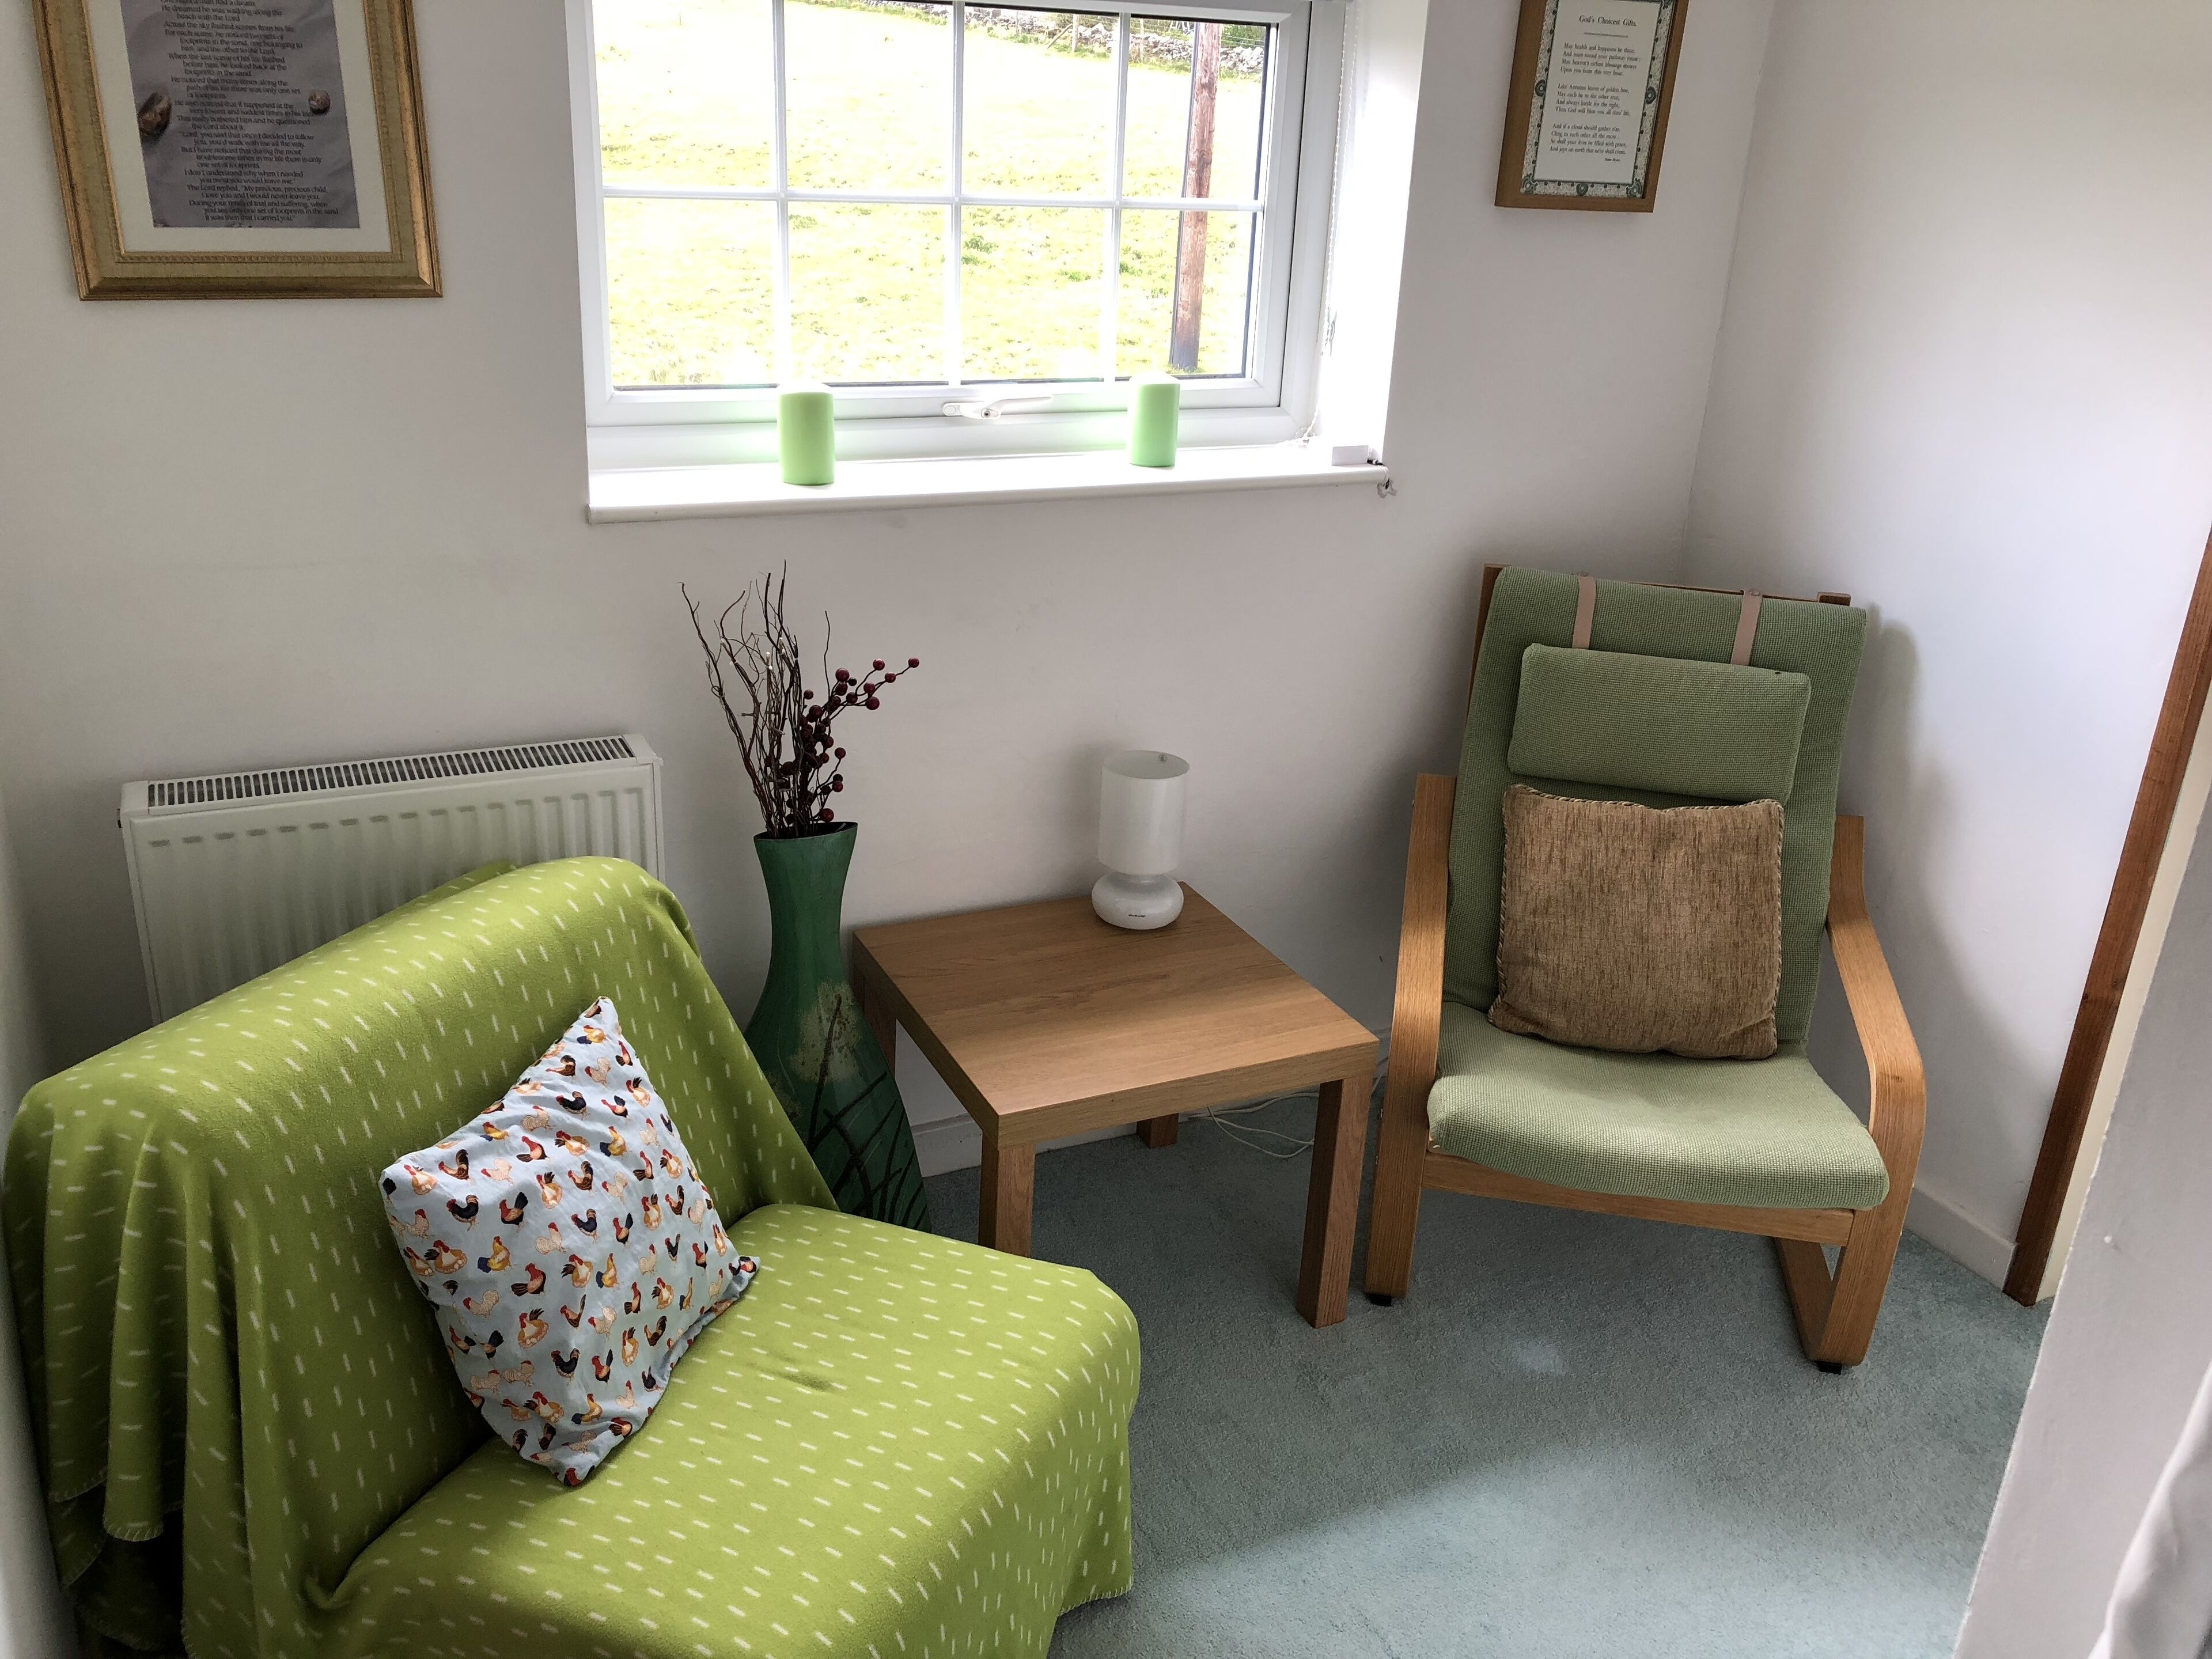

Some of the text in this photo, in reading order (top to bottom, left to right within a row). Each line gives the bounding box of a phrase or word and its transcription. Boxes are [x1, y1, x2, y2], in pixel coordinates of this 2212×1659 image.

[1580, 15, 1637, 27] God's Choicest Gifts.
